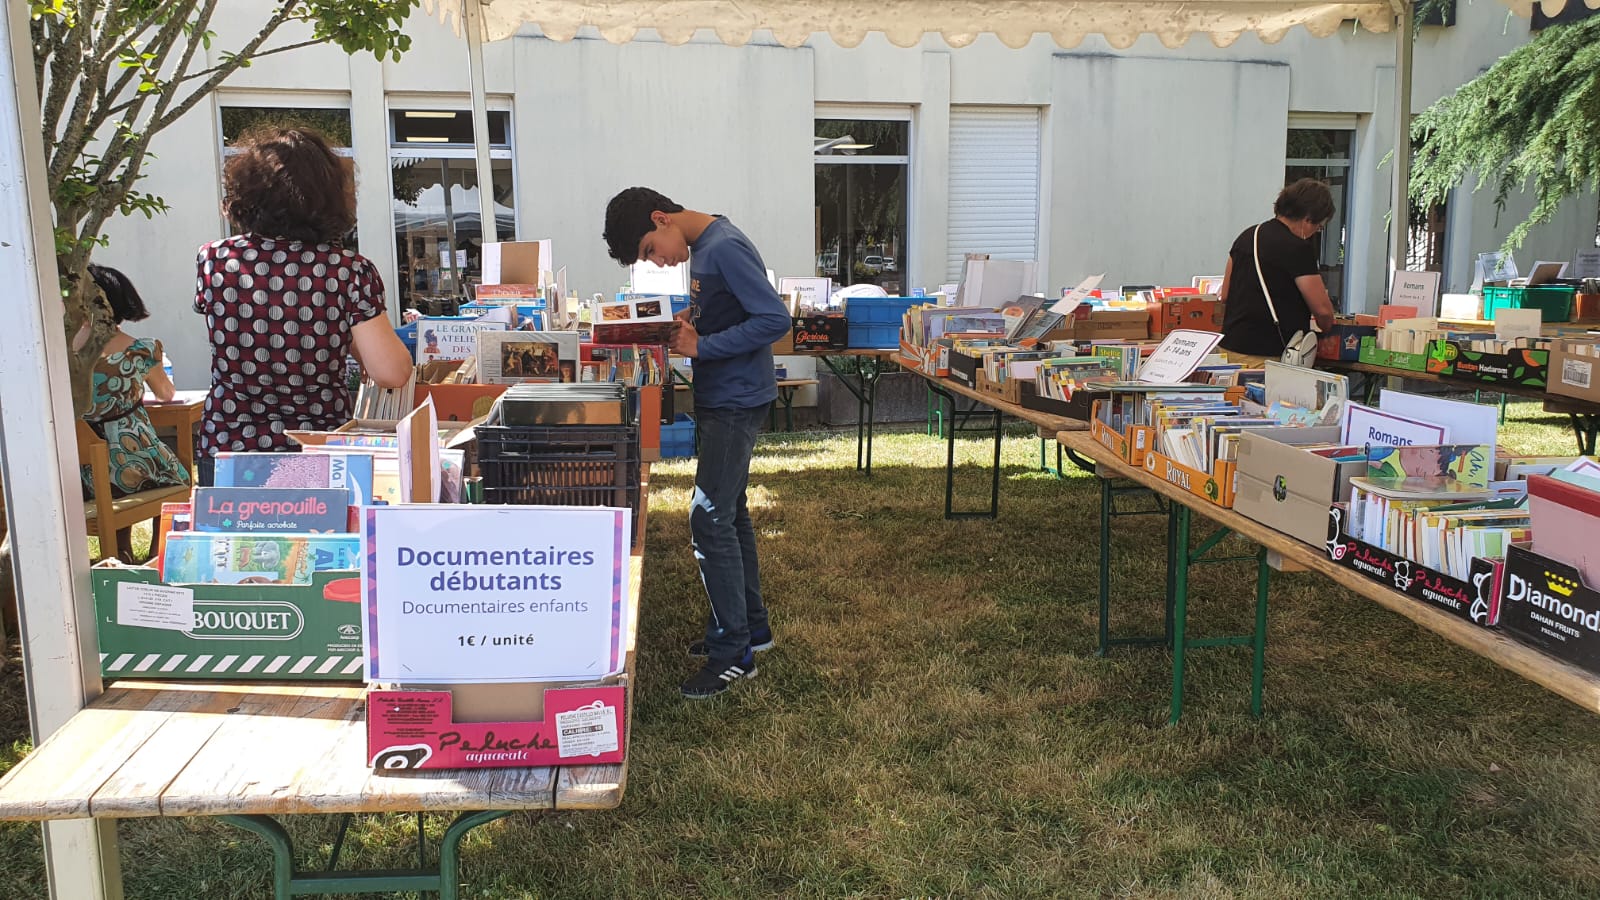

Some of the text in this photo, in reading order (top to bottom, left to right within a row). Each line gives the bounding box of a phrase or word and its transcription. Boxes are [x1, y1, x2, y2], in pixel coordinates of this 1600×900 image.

[436, 324, 487, 333] LE GRAND
[1172, 337, 1198, 348] Romans
[1368, 426, 1413, 447] Romans
[332, 459, 345, 480] Ma
[208, 496, 327, 520] La grenouille
[236, 519, 297, 529] Parfaite acrobate
[397, 547, 595, 566] Documentaires
[1347, 542, 1394, 572] Peluche
[430, 571, 562, 591] débutants
[1415, 570, 1471, 603] Peluche
[402, 599, 588, 615] Documentaires enfants
[1422, 588, 1462, 610] aguacate
[1506, 573, 1600, 632] Diamond
[193, 612, 291, 631] BOUQUET
[1530, 611, 1580, 638] DAHAN FRUITS
[458, 633, 534, 647] 1€ / unité
[439, 731, 558, 751] Peluche
